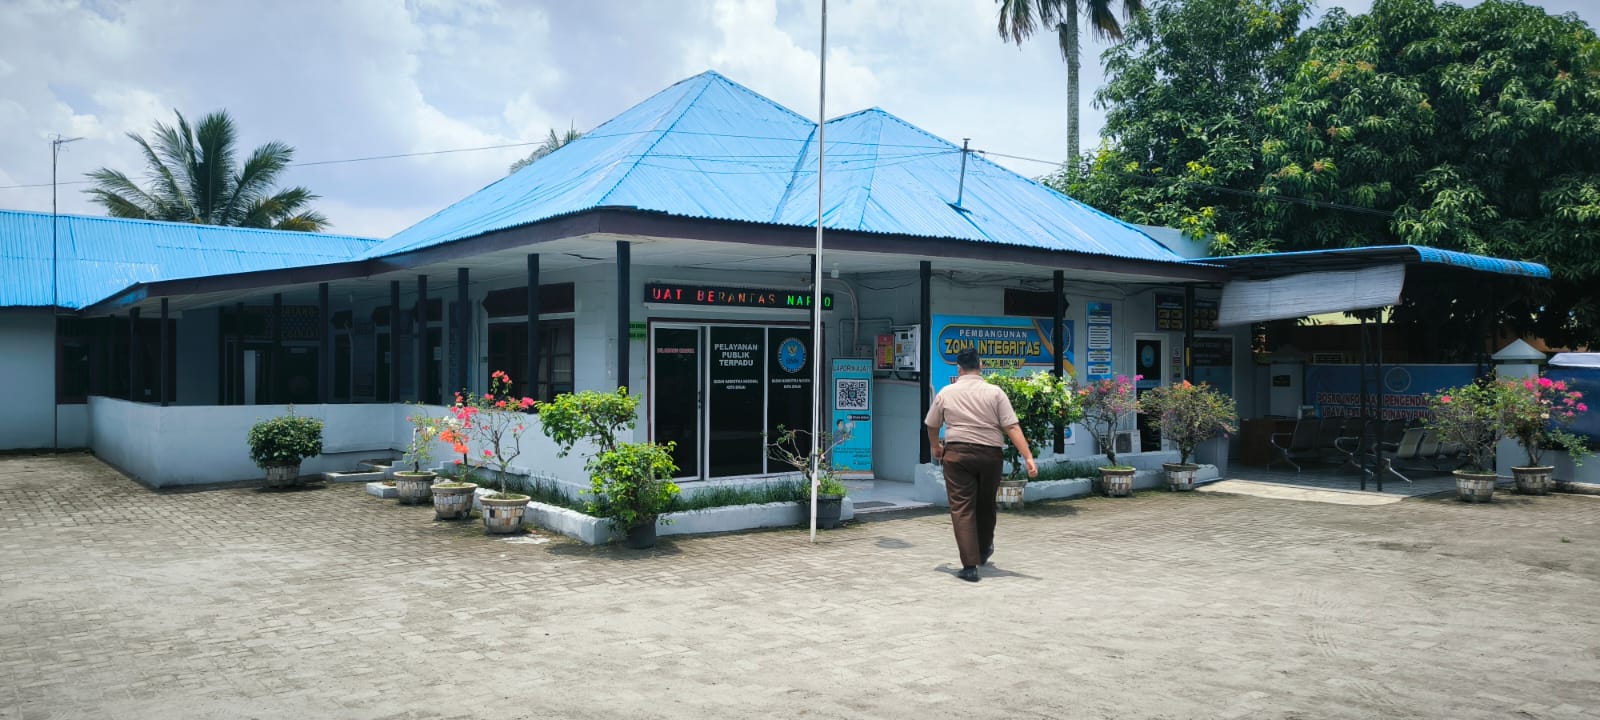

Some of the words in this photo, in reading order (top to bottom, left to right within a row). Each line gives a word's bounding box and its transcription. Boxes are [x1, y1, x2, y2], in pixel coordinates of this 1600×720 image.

[653, 287, 682, 300] UAT
[697, 289, 775, 304] BERANTAS
[787, 295, 831, 308] NARO
[959, 329, 1028, 338] PEMBANGUNAN
[714, 343, 758, 351] PELAYANAN
[945, 339, 975, 354] ZONA
[977, 340, 1040, 356] INTEGRITAS
[722, 351, 750, 359] PUBLIK
[719, 359, 754, 367] TERPADU
